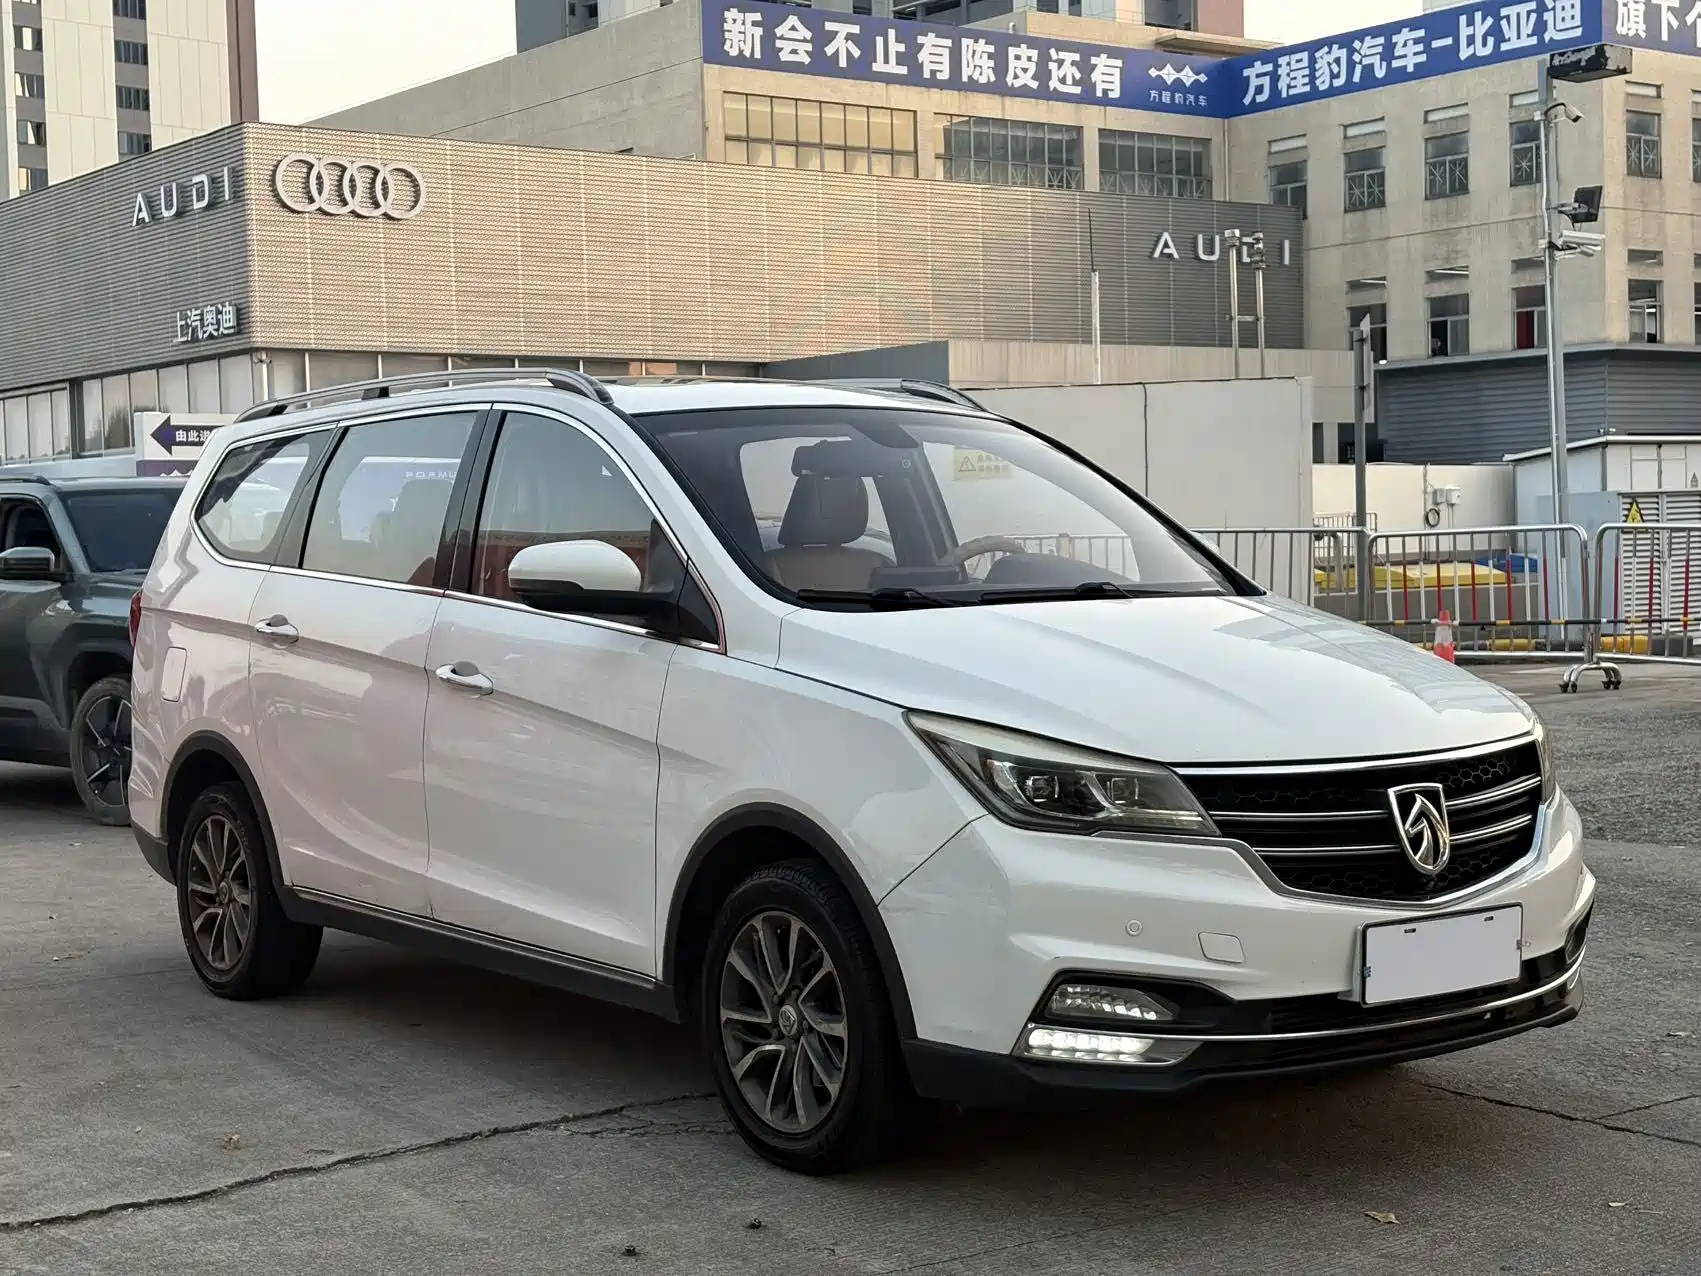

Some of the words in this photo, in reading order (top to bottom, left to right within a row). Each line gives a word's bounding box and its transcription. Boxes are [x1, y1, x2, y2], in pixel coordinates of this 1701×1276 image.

[723, 7, 1123, 98] 新会不止有陈皮还有
[1149, 89, 1208, 107] 方程豹汽车
[132, 165, 230, 226] AUDI
[173, 301, 237, 342] 上汽奥迪
